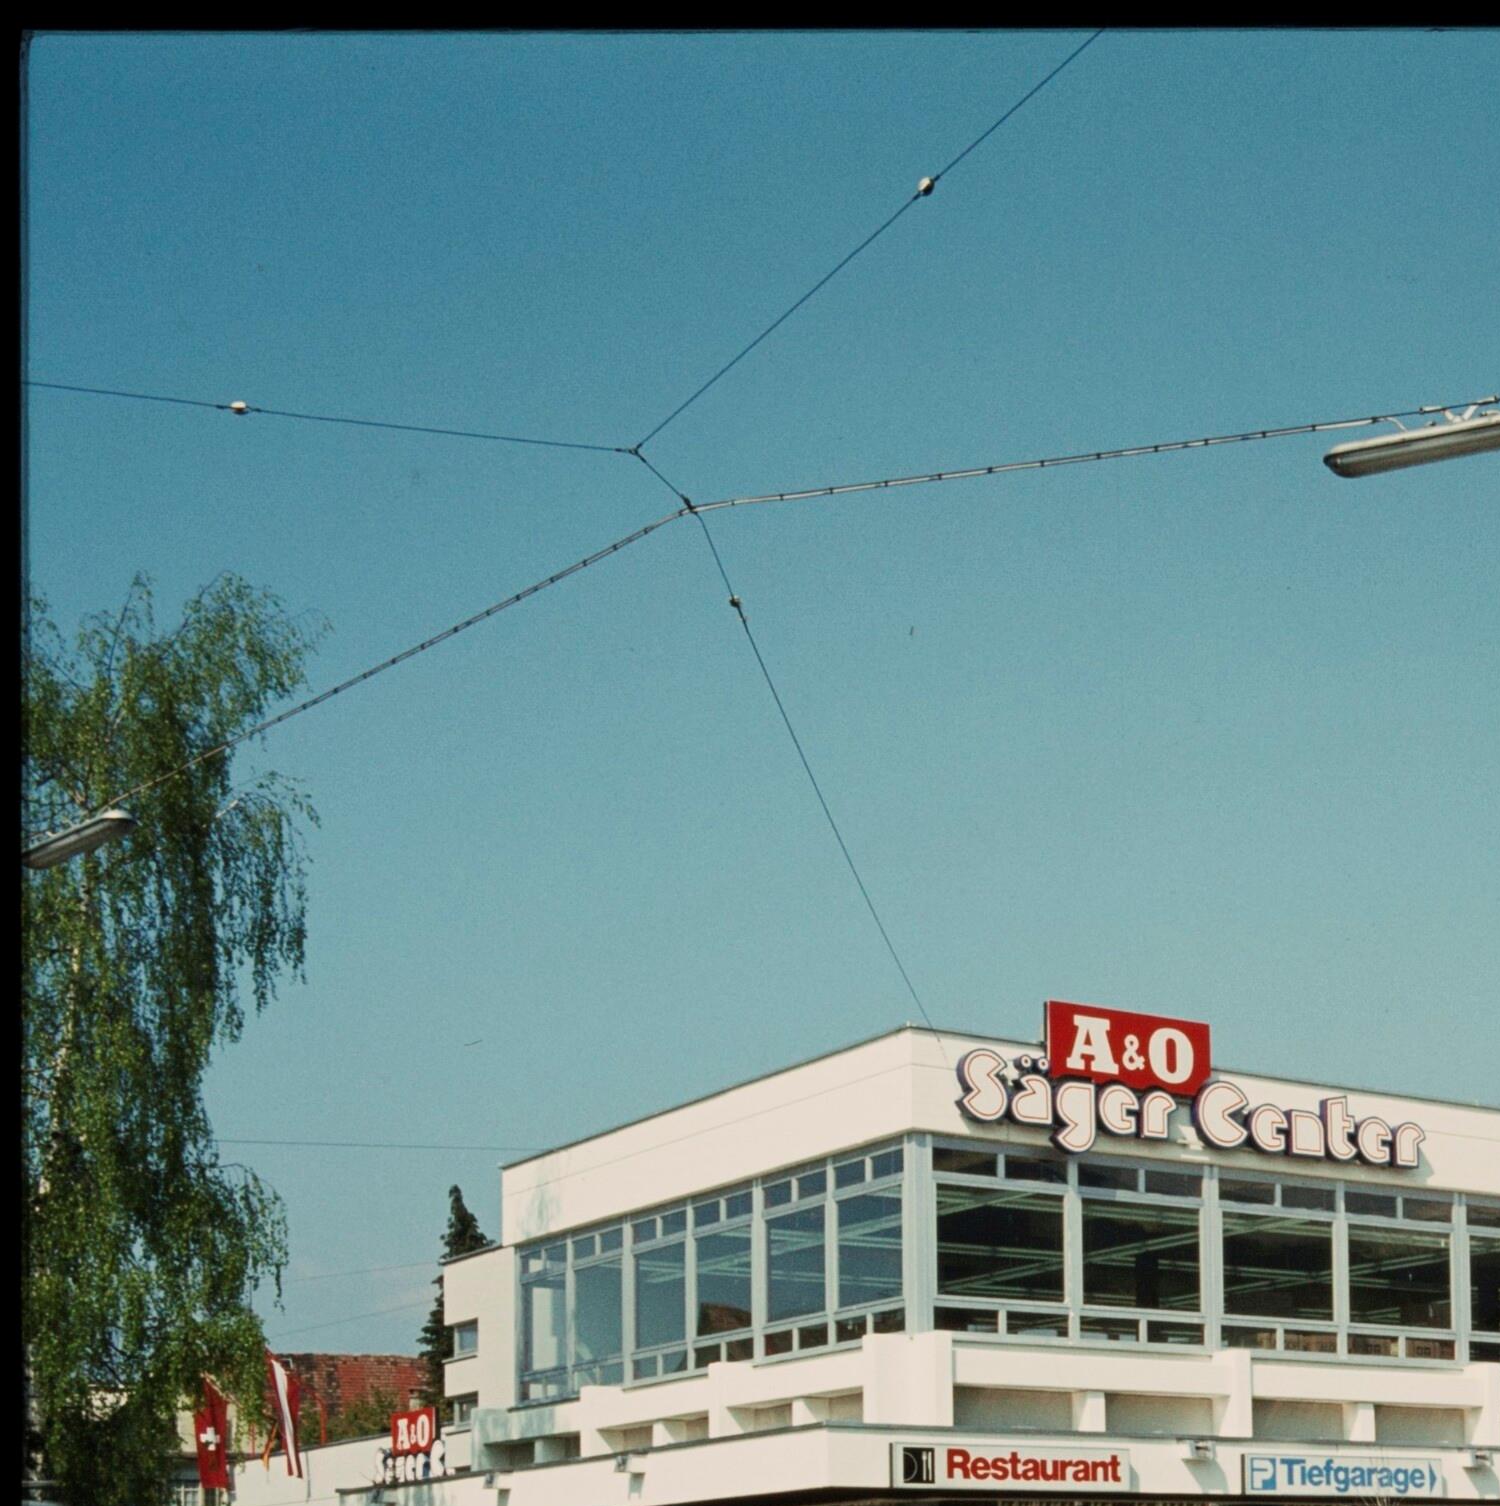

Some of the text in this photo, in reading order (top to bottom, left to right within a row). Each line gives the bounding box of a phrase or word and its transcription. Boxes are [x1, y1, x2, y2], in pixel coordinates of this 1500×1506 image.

[1065, 1014, 1195, 1085] A&O
[957, 1048, 1427, 1169] Säger Center
[396, 1413, 430, 1451] A&O
[946, 1447, 1122, 1483] Restaurant
[1280, 1457, 1425, 1494] Tiefgarage
